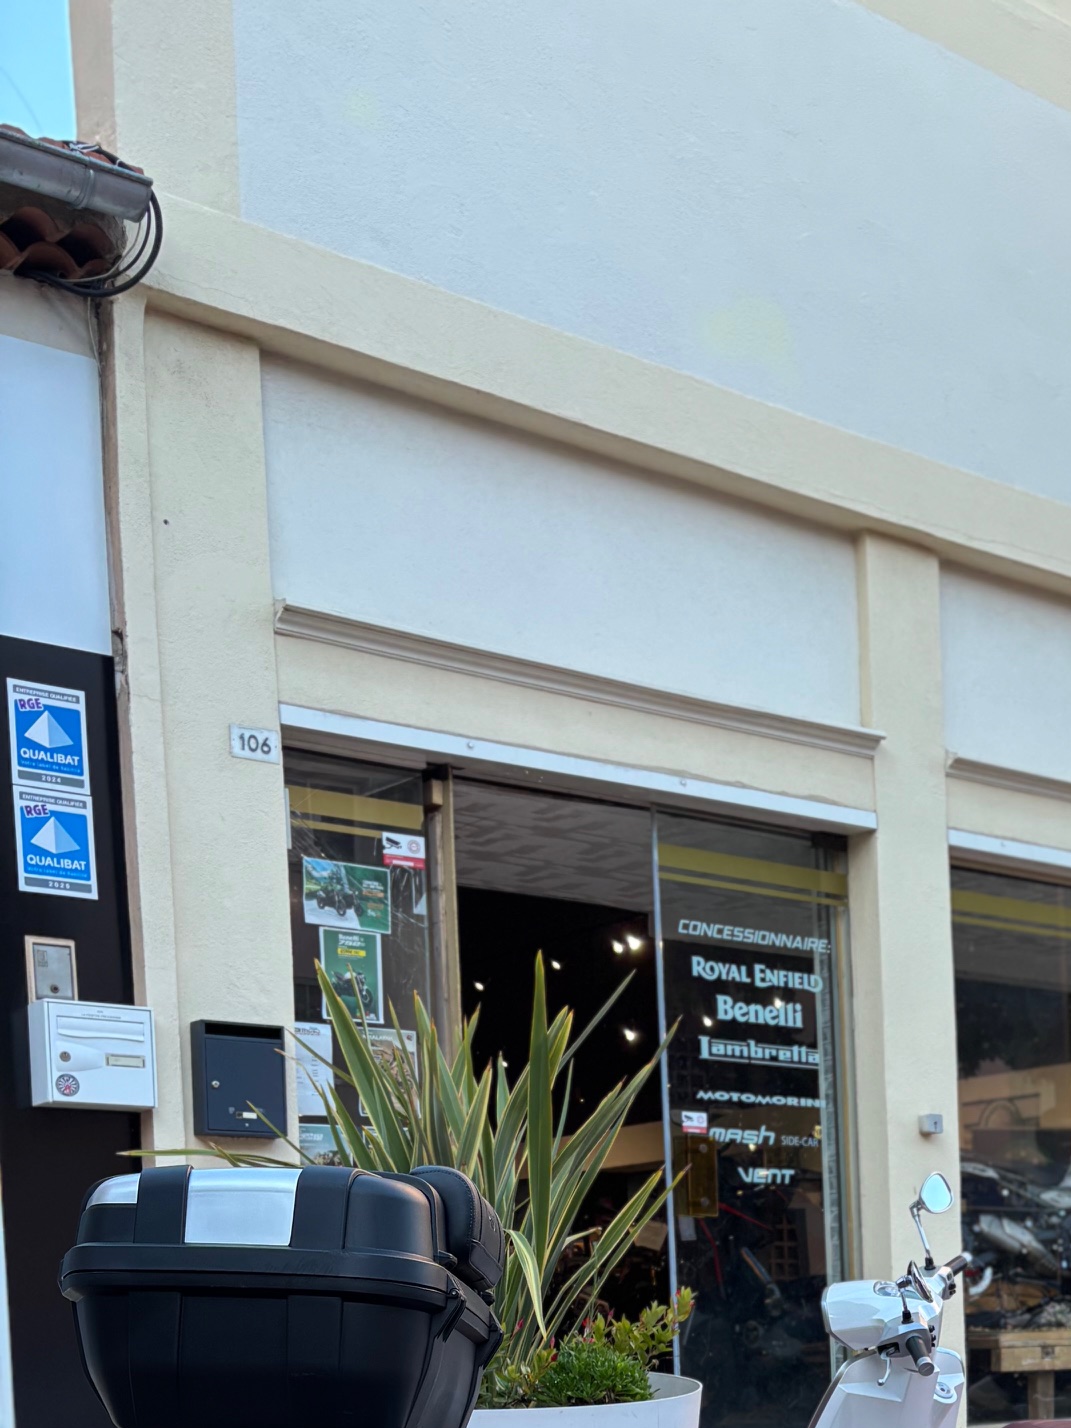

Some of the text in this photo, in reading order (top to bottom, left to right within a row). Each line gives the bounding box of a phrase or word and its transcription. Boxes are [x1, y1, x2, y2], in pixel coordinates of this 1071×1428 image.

[15, 686, 50, 698] ENTREPRISE
[18, 698, 43, 711] RGE
[238, 732, 272, 755] 106
[20, 748, 80, 766] QUALIBAT
[22, 793, 56, 803] ENTREPRISE
[24, 804, 49, 817] RGE
[26, 854, 87, 871] QUALIBAT
[691, 955, 824, 993] ROYAL ENFIELD
[716, 994, 804, 1029] Benelli
[698, 1035, 821, 1068] Lambretta
